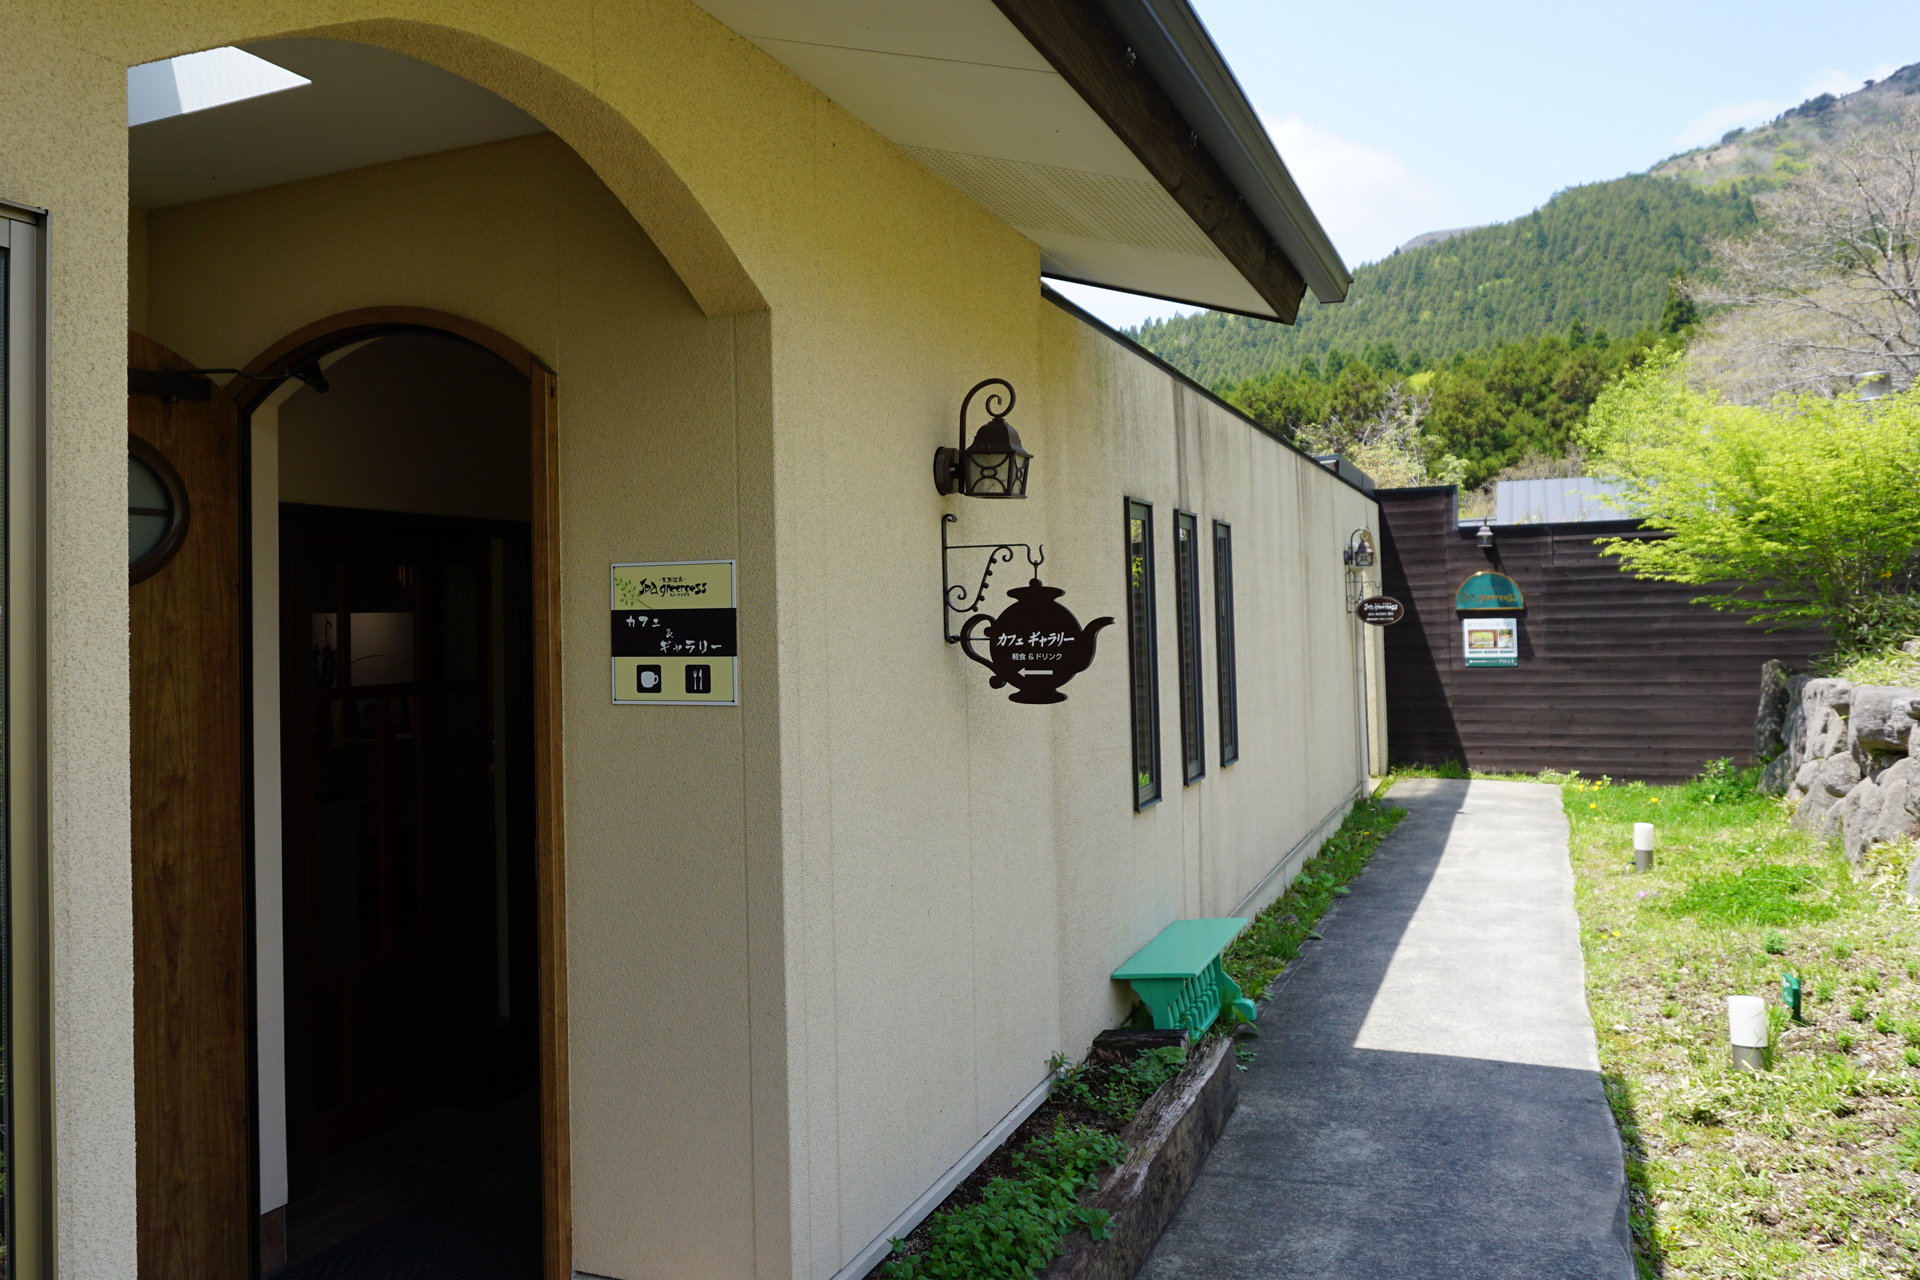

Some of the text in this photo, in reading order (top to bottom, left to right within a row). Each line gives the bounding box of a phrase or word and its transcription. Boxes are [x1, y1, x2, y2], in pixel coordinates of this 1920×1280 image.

[639, 577, 707, 597] Spa greenness
[626, 615, 660, 628] カフェ
[666, 628, 674, 639] &
[996, 631, 1075, 647] カフェ ギャラリー
[660, 640, 722, 653] ギャラリー
